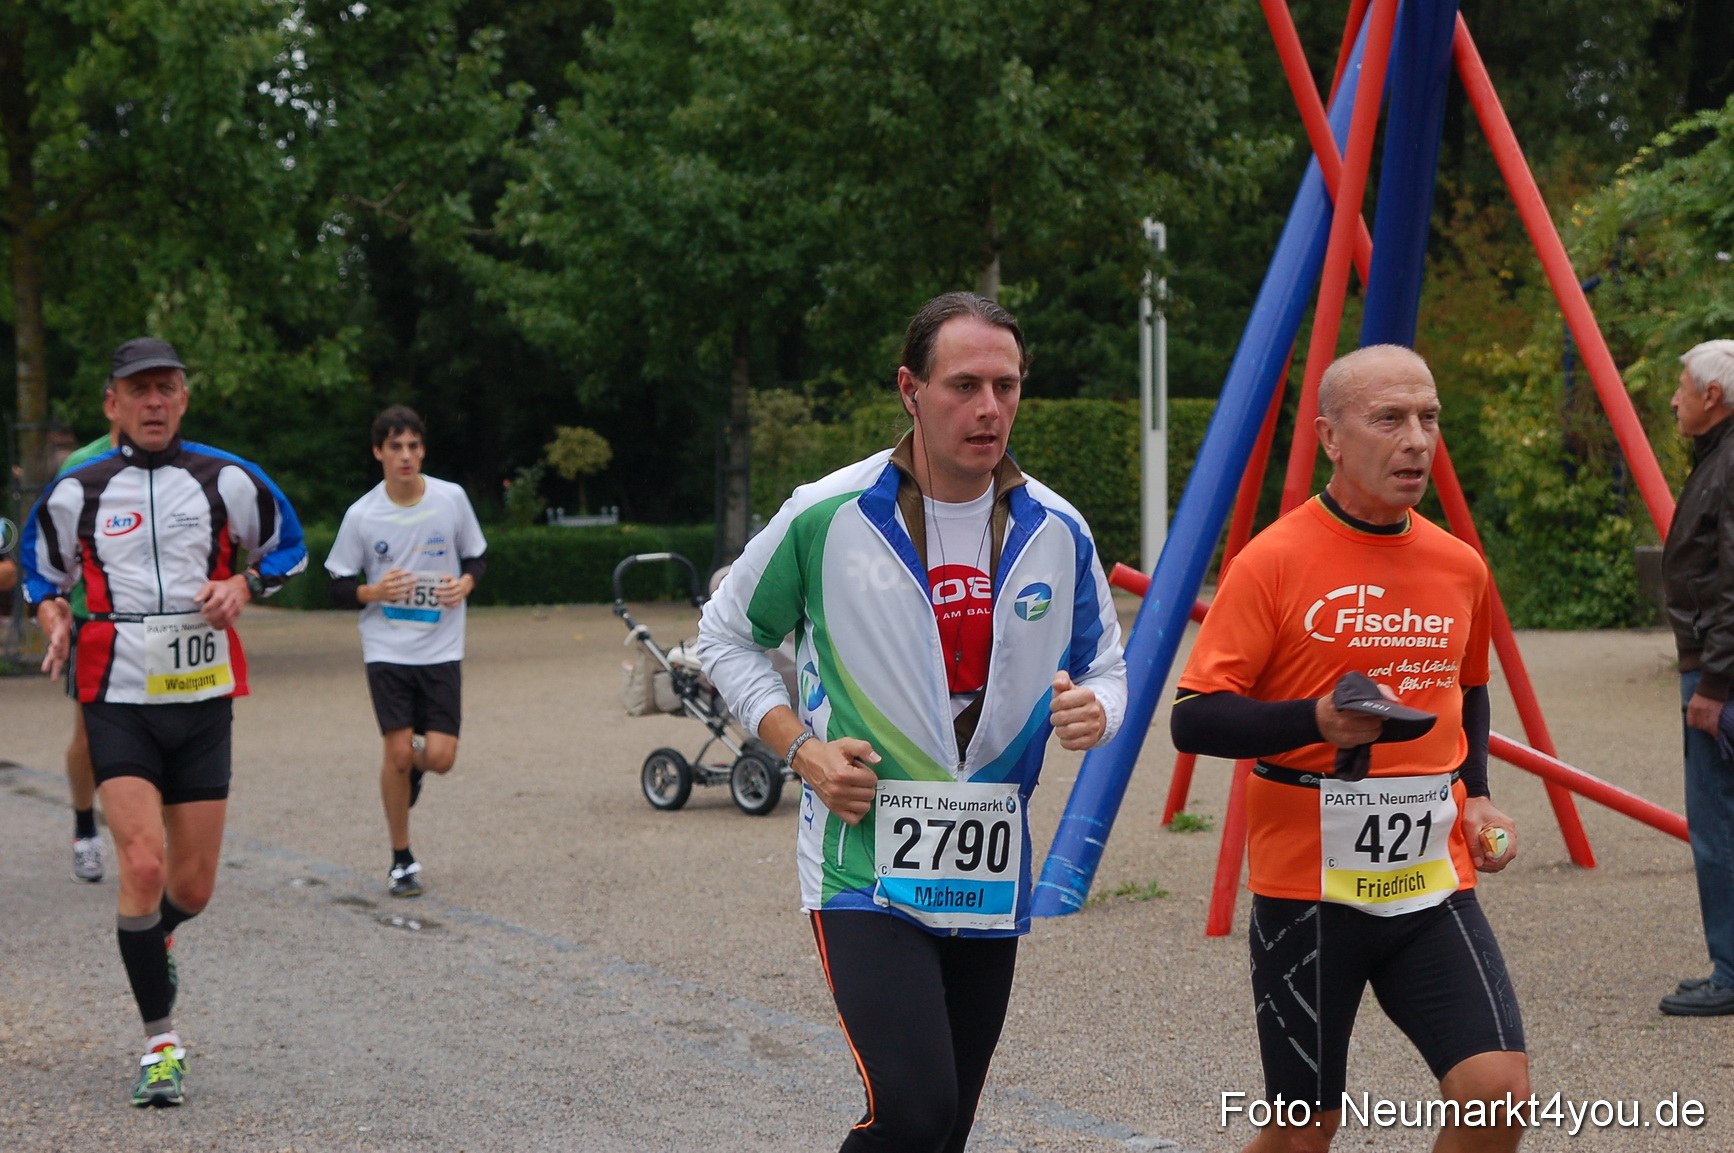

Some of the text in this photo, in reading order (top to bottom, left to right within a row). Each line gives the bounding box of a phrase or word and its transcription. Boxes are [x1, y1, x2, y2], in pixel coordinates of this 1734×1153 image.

[943, 610, 962, 620] AM
[967, 608, 992, 616] BAL
[1335, 607, 1454, 634] Fischer
[168, 631, 215, 669] 106
[1347, 636, 1449, 649] AUTOMOBILE
[1367, 661, 1394, 677] und
[1396, 658, 1421, 674] das
[1398, 676, 1435, 695] fährt
[880, 794, 1003, 812] PARTL Neumarkt
[1324, 790, 1437, 806] PARTL Neumarkt
[892, 817, 1011, 874] 2790
[1354, 810, 1432, 864] 421
[1356, 871, 1426, 898] Friedrich
[914, 886, 985, 908] Michael
